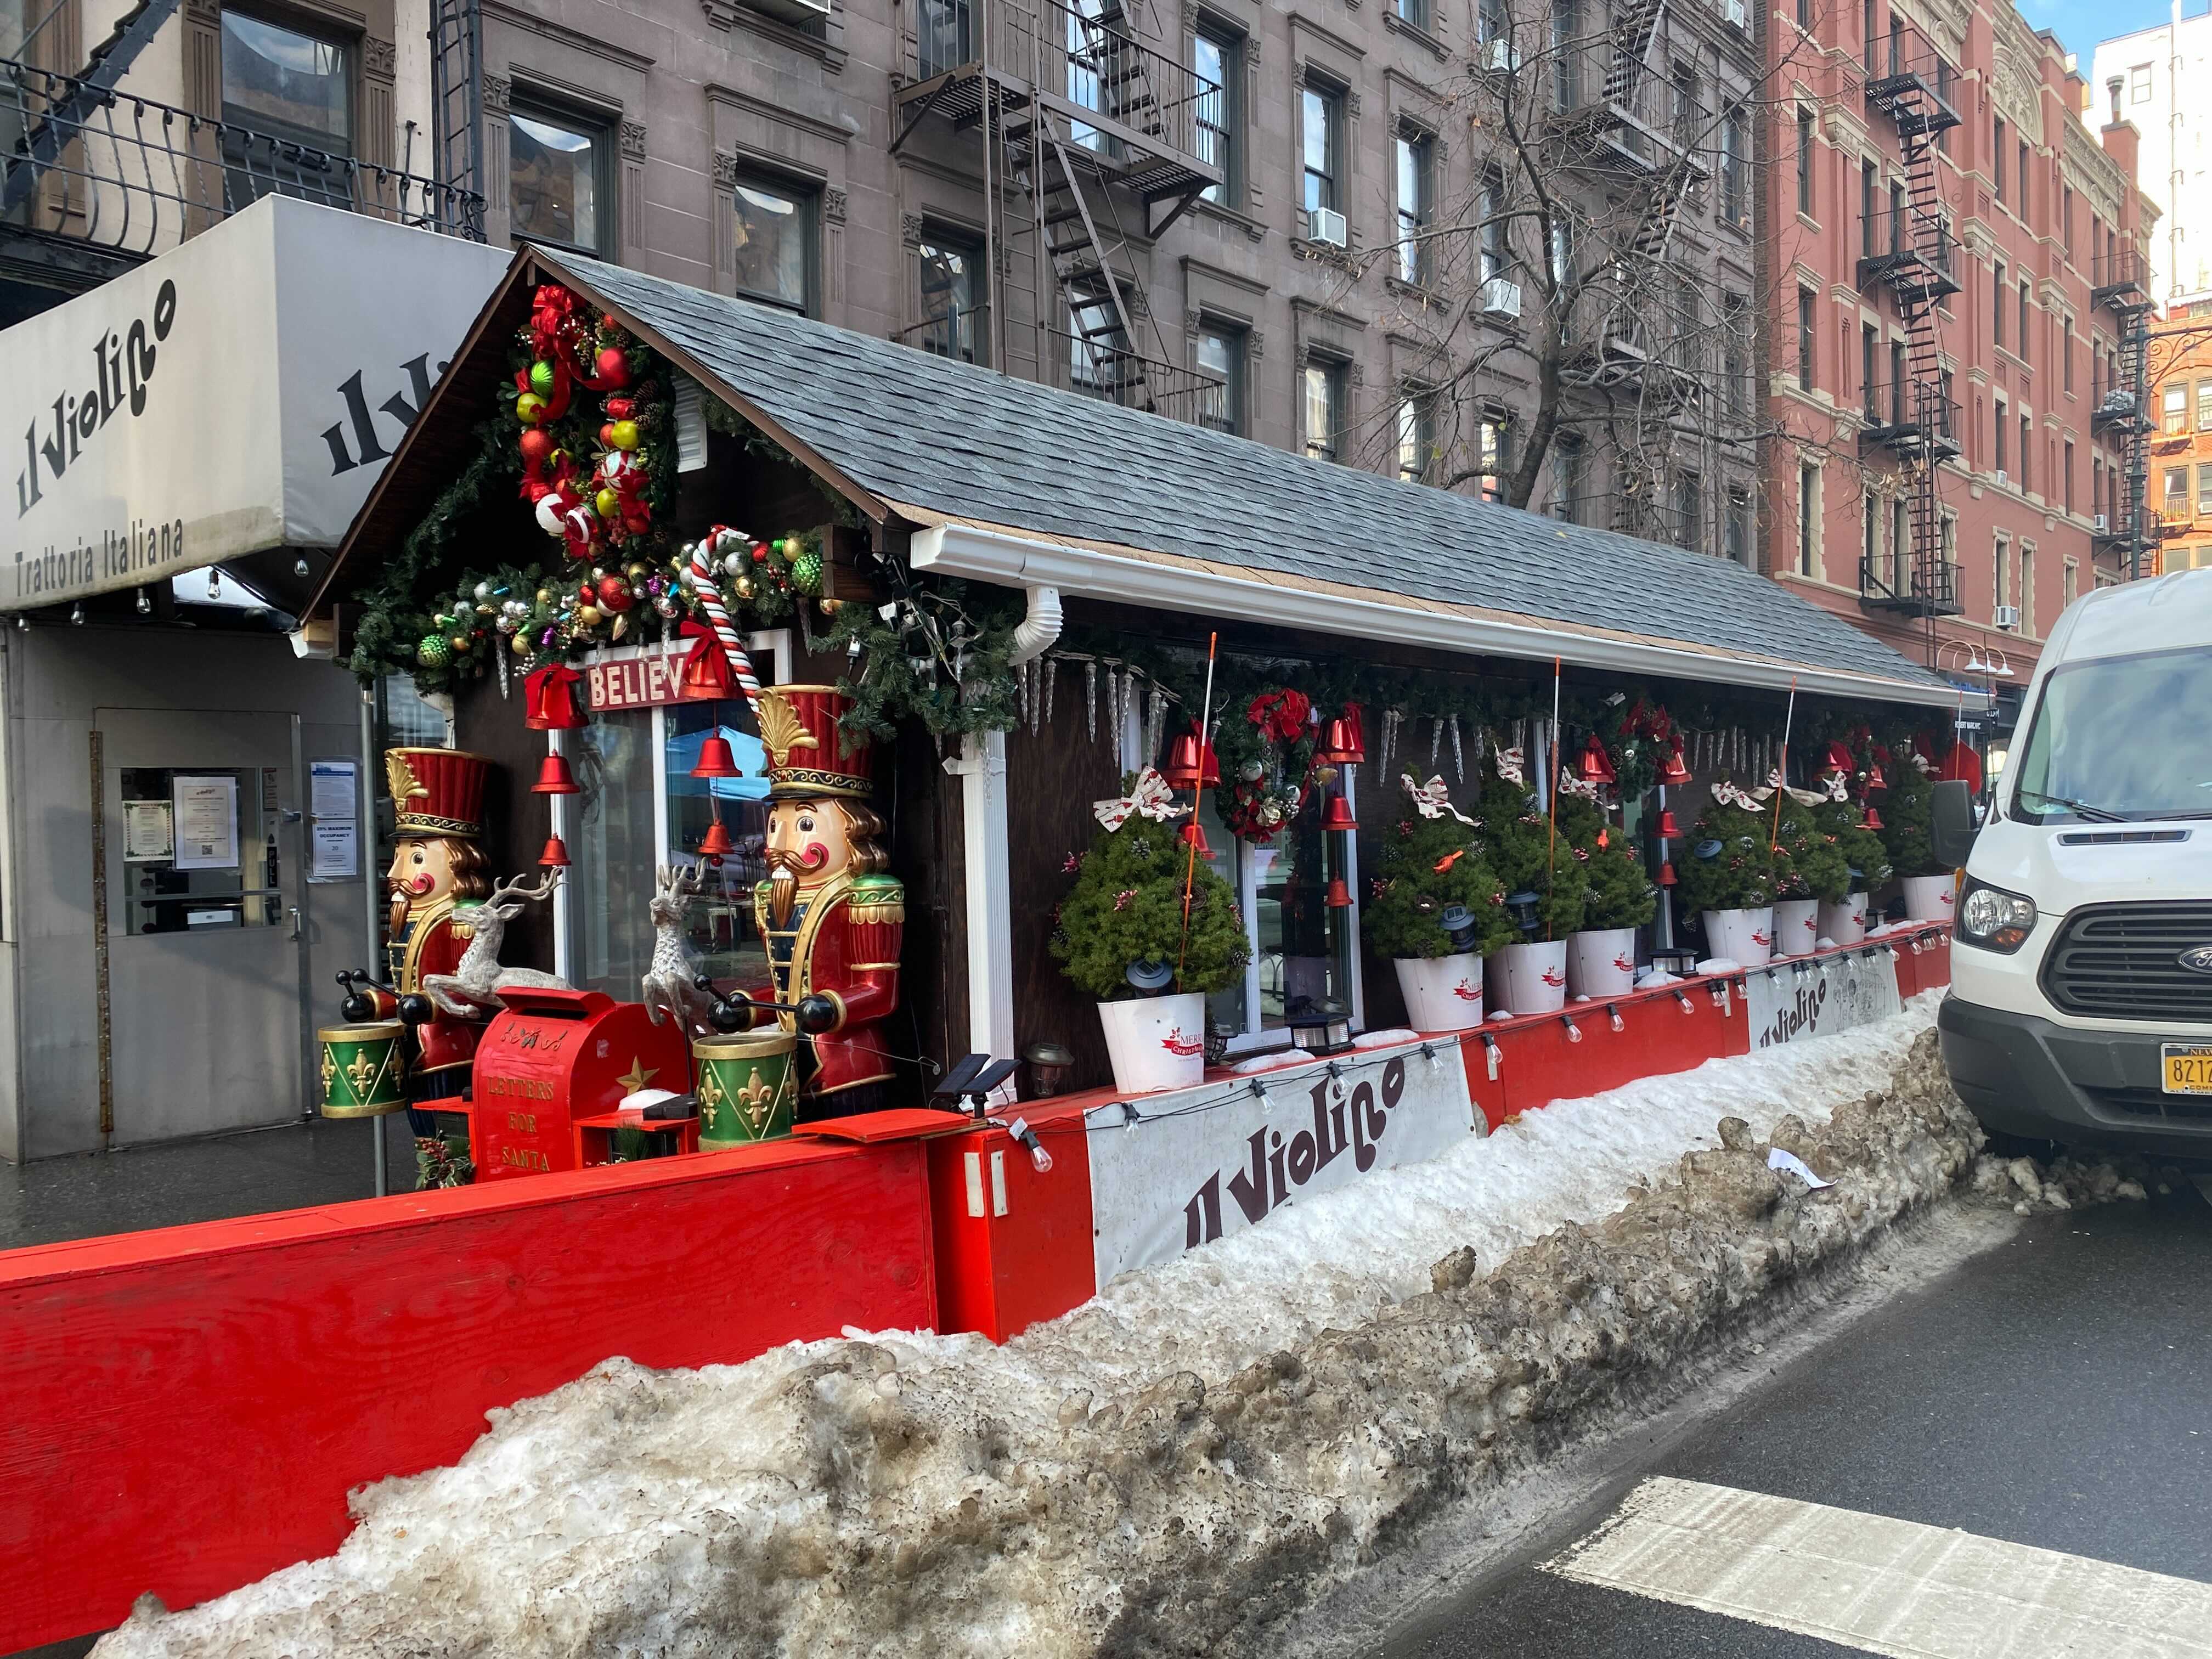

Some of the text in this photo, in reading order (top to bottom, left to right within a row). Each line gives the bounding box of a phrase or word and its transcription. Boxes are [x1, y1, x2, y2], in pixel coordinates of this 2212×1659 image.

[15, 518, 183, 597] Trattoria Italiana
[589, 657, 685, 707] BELIEV
[1181, 1034, 1203, 1045] MERR
[488, 1076, 554, 1101] LETTERS
[508, 1111, 537, 1133] FOR
[501, 1146, 550, 1172] SANTA
